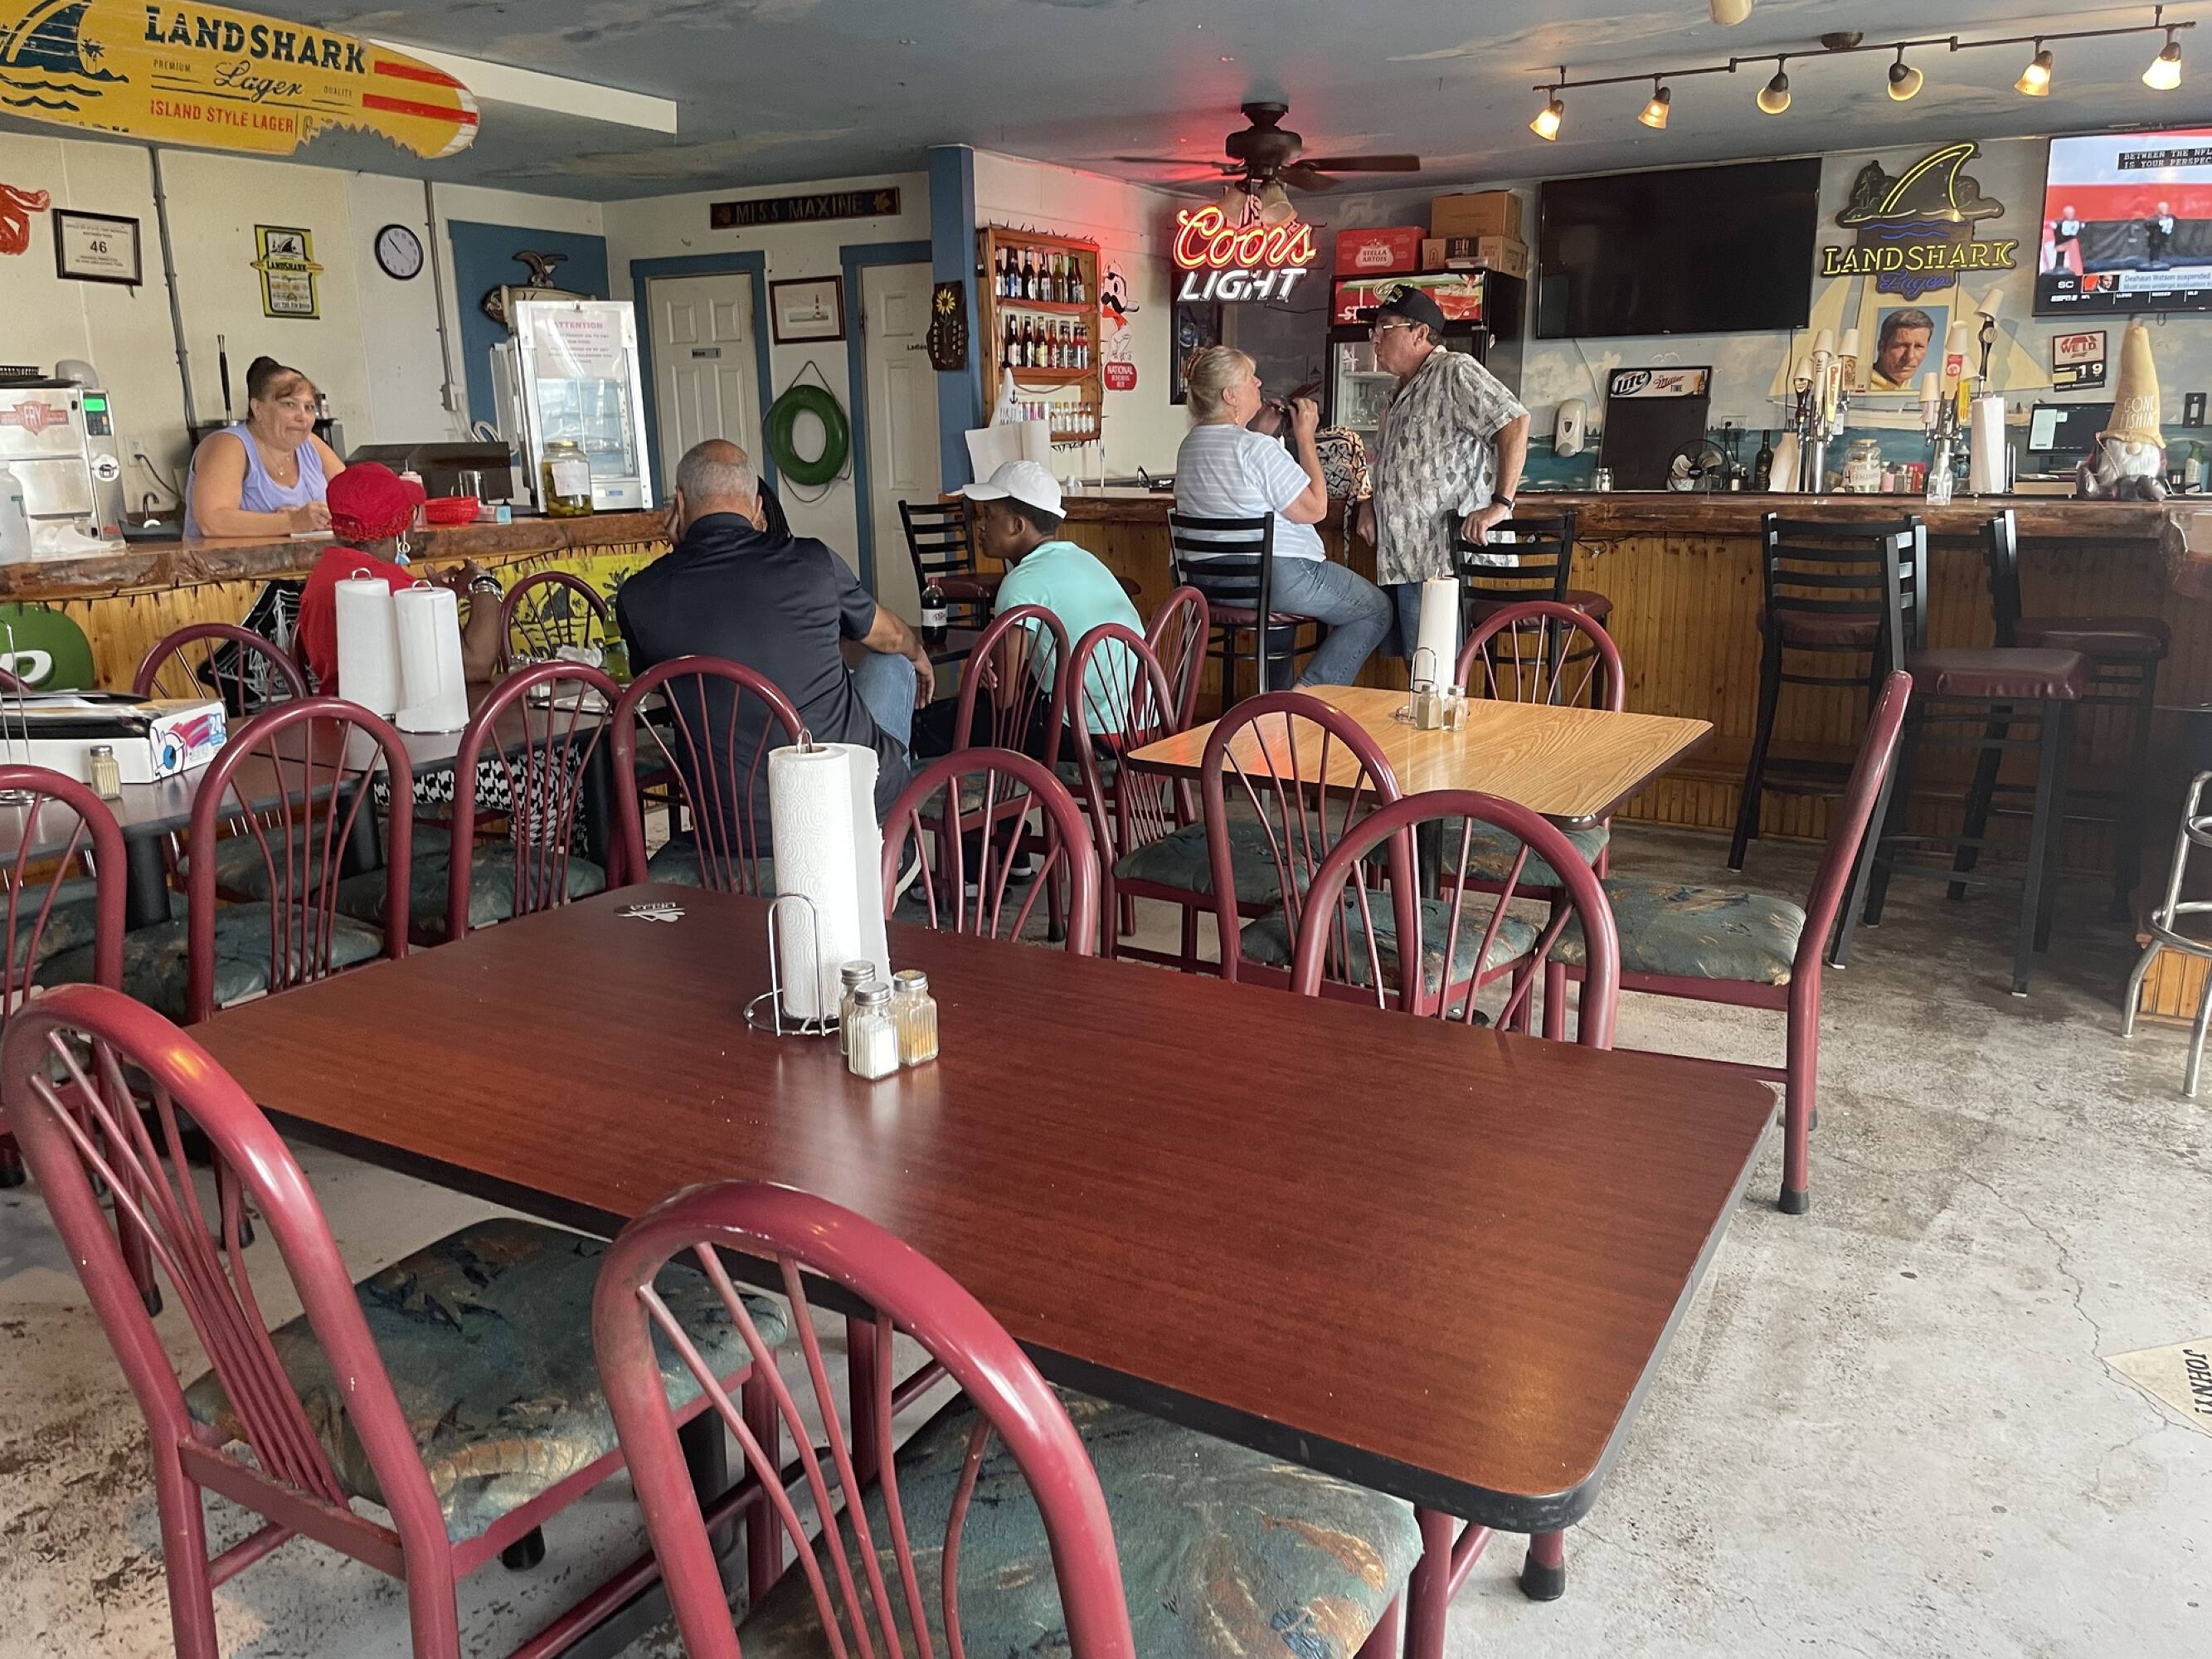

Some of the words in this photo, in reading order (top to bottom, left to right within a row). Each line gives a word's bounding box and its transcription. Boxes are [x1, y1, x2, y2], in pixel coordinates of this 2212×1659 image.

[144, 5, 366, 74] LANDSHARK
[153, 59, 192, 72] PREMIUM
[213, 60, 304, 103] Lager
[150, 99, 202, 120] ISLAND
[207, 108, 248, 127] STYLE
[252, 116, 294, 134] LAGER
[2124, 151, 2166, 160] BETWEEN
[2194, 148, 2212, 156] NFL
[2141, 159, 2164, 168] YOUR
[735, 203, 780, 225] MISS
[789, 192, 863, 220] MAXINE
[90, 241, 108, 254] 46
[1174, 204, 1317, 270] Coors
[1823, 242, 2015, 275] LANDSHARK
[1178, 268, 1308, 302] LIGHT
[1879, 271, 1955, 296] Lager
[1107, 365, 1133, 374] NATIONAL
[1615, 372, 1647, 395] Lite
